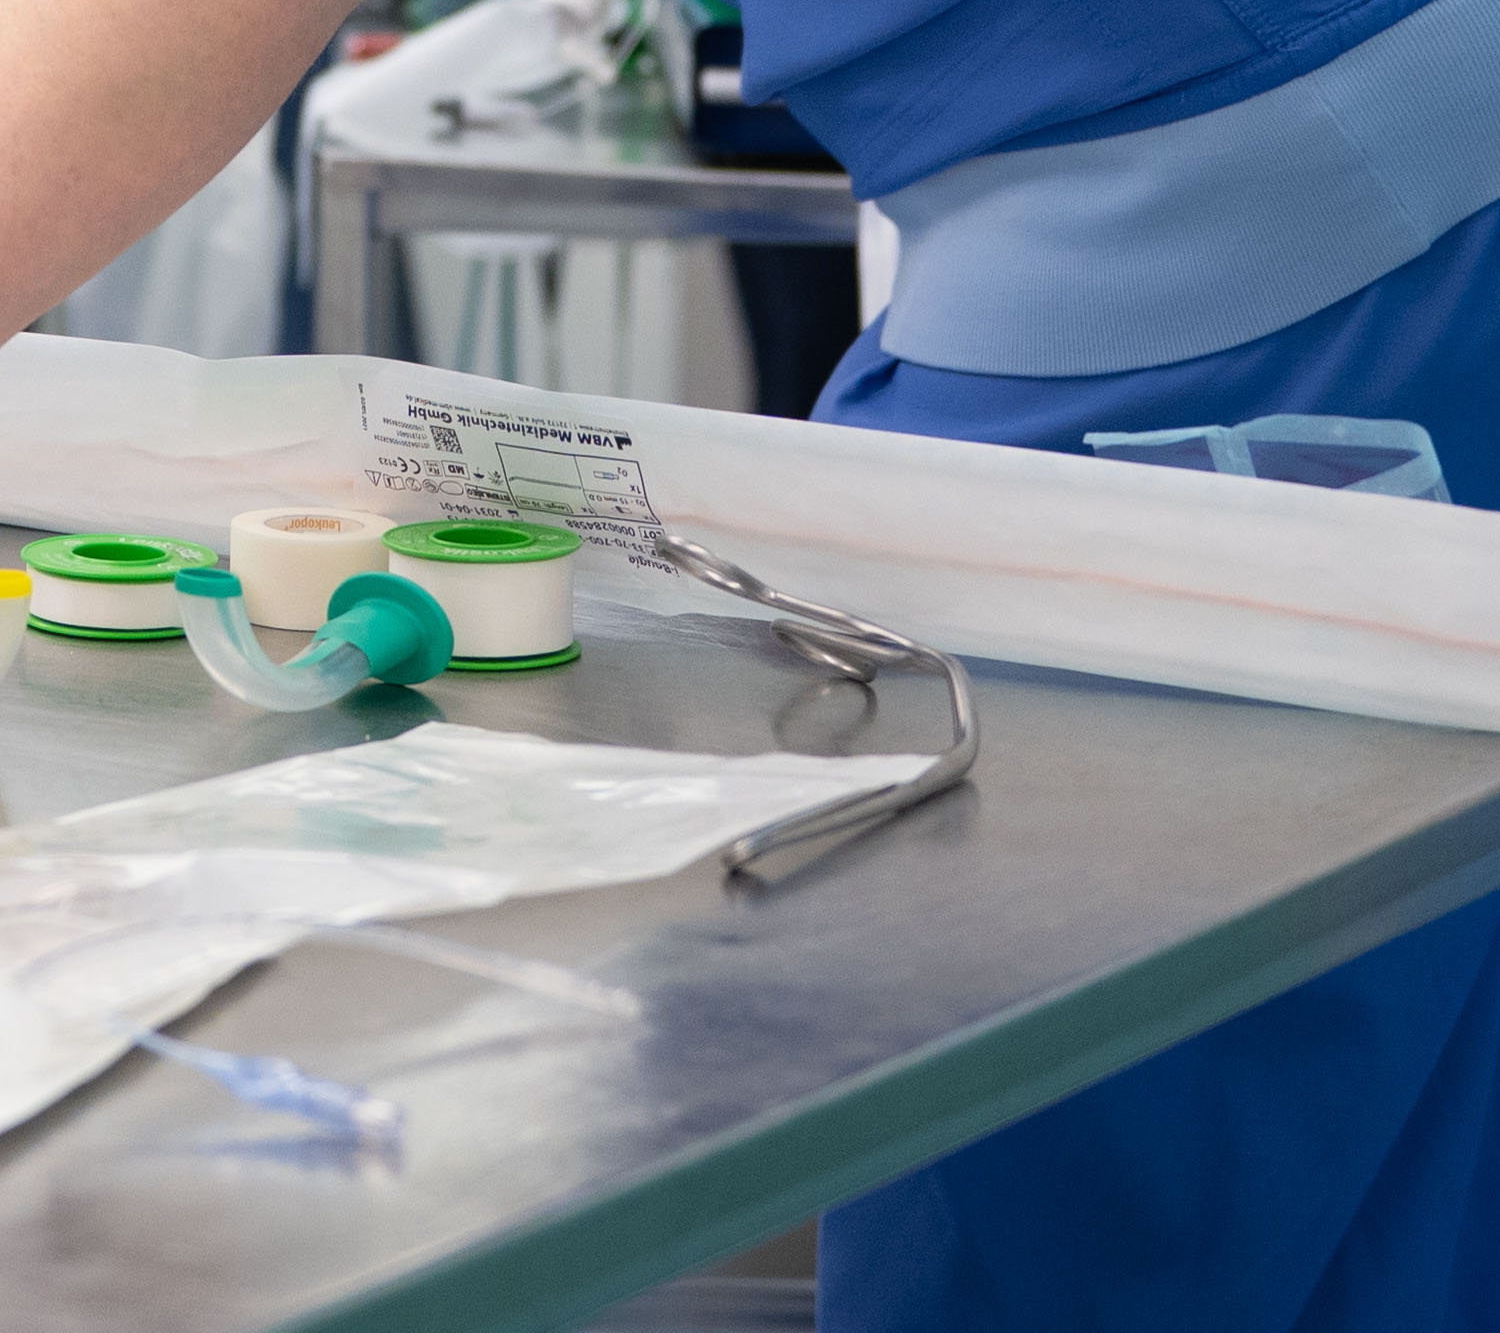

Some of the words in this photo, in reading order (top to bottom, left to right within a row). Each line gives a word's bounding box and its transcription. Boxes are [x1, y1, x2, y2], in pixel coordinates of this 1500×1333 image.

[407, 404, 453, 424] GmbH
[457, 413, 572, 443] Medizintechnik
[577, 432, 614, 448] VBM
[378, 456, 397, 468] 0123
[447, 464, 465, 475] MD
[629, 484, 642, 494] 1x
[440, 501, 502, 518] 2031-04-01
[565, 519, 636, 537] 0000284588
